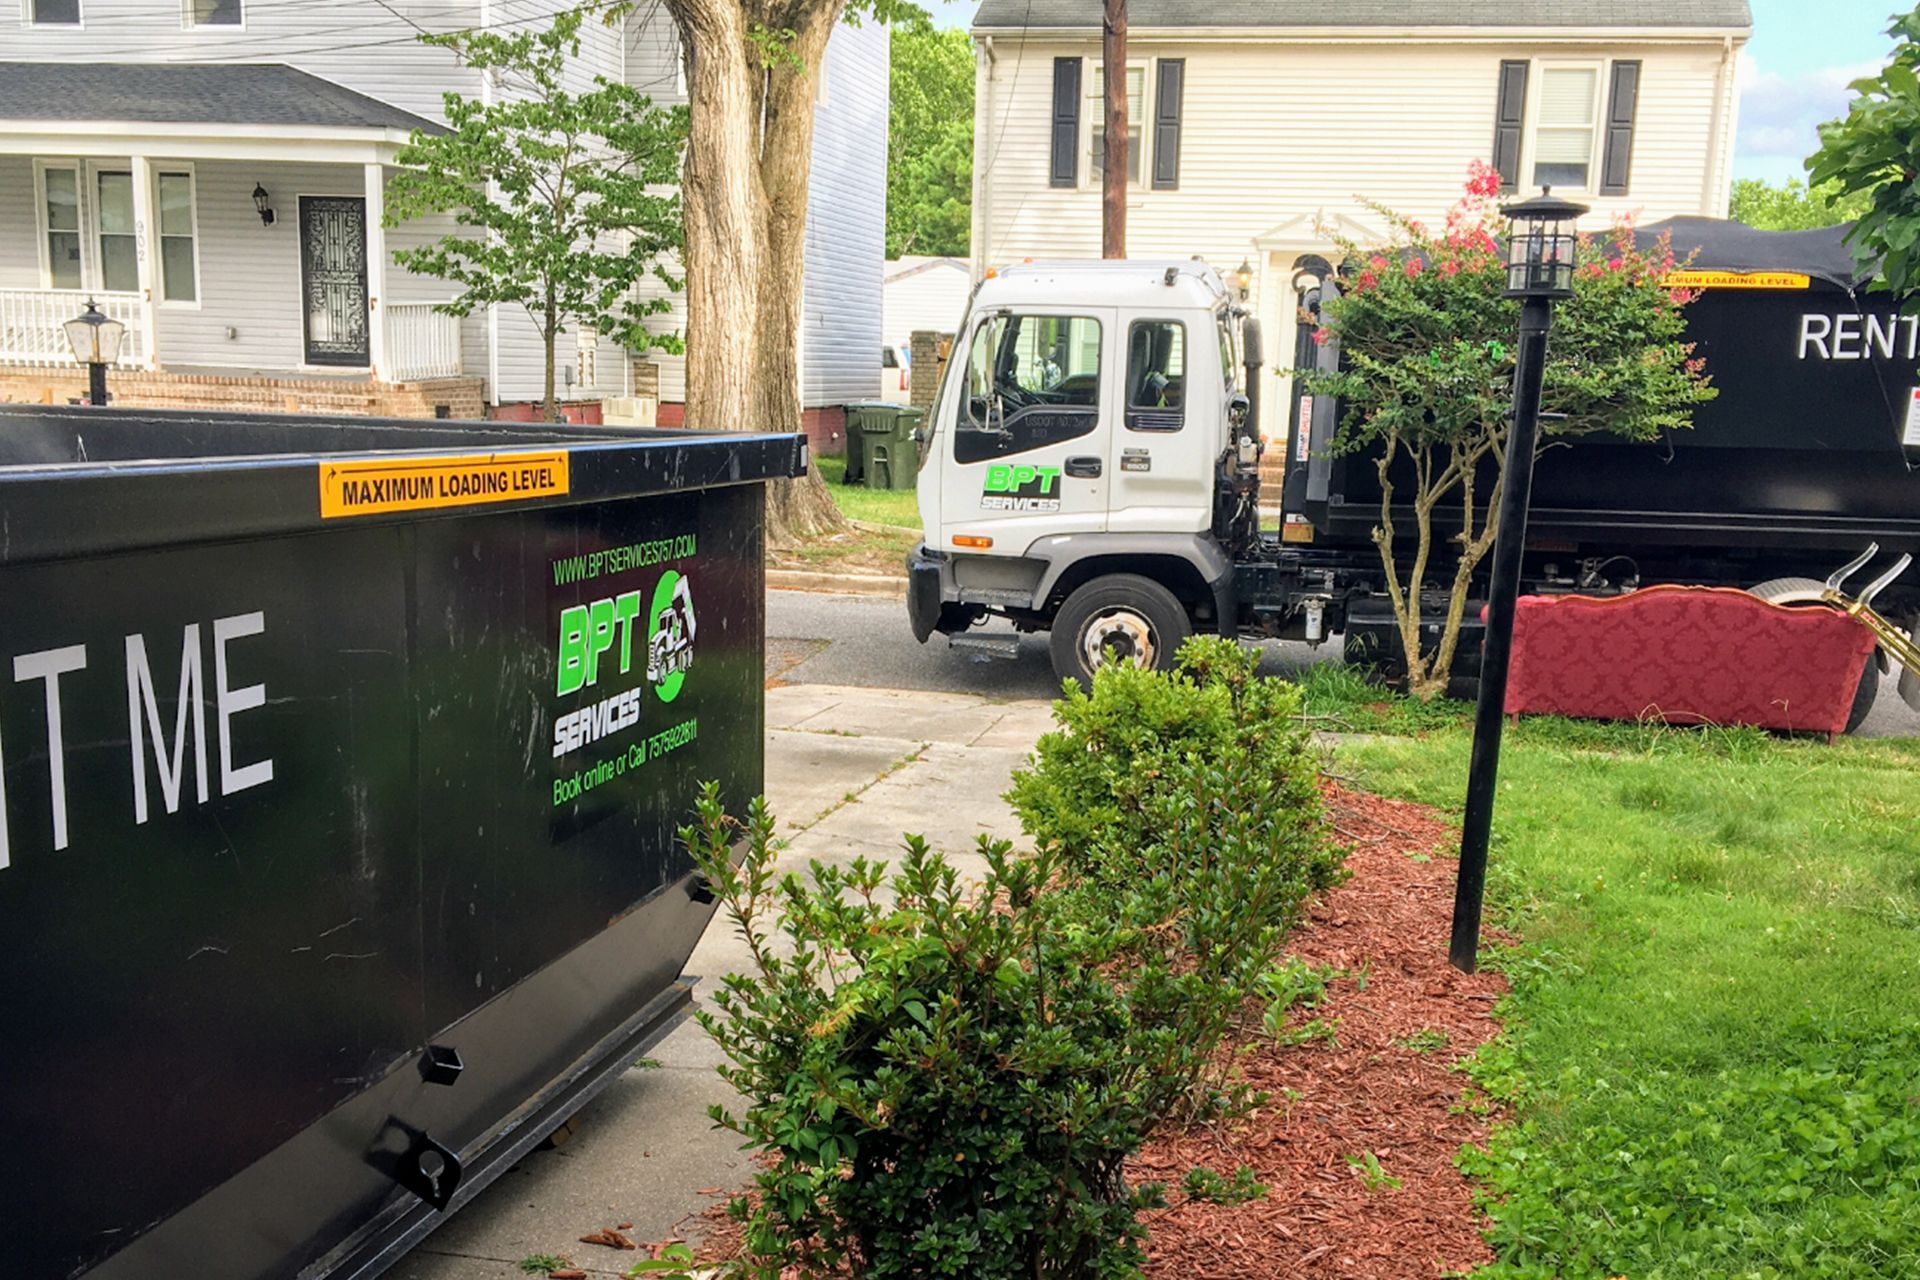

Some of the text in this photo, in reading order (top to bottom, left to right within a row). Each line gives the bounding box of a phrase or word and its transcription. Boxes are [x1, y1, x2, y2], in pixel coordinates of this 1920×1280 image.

[136, 220, 145, 262] 902
[1706, 276, 1757, 285] LOADING
[1760, 276, 1797, 286] LEVEL
[343, 468, 555, 505] MAXIMUM LOADING LEVEL
[984, 464, 1060, 494] BPT
[981, 496, 1060, 511] SERVICES
[553, 533, 697, 586] WWW.BPTSERVICES757.COM
[557, 590, 641, 697] BPT
[0, 611, 274, 870] T ME
[552, 687, 641, 758] SERVICES
[553, 771, 582, 806] Book
[584, 759, 615, 790] online
[616, 753, 627, 775] or
[628, 740, 646, 769] Call
